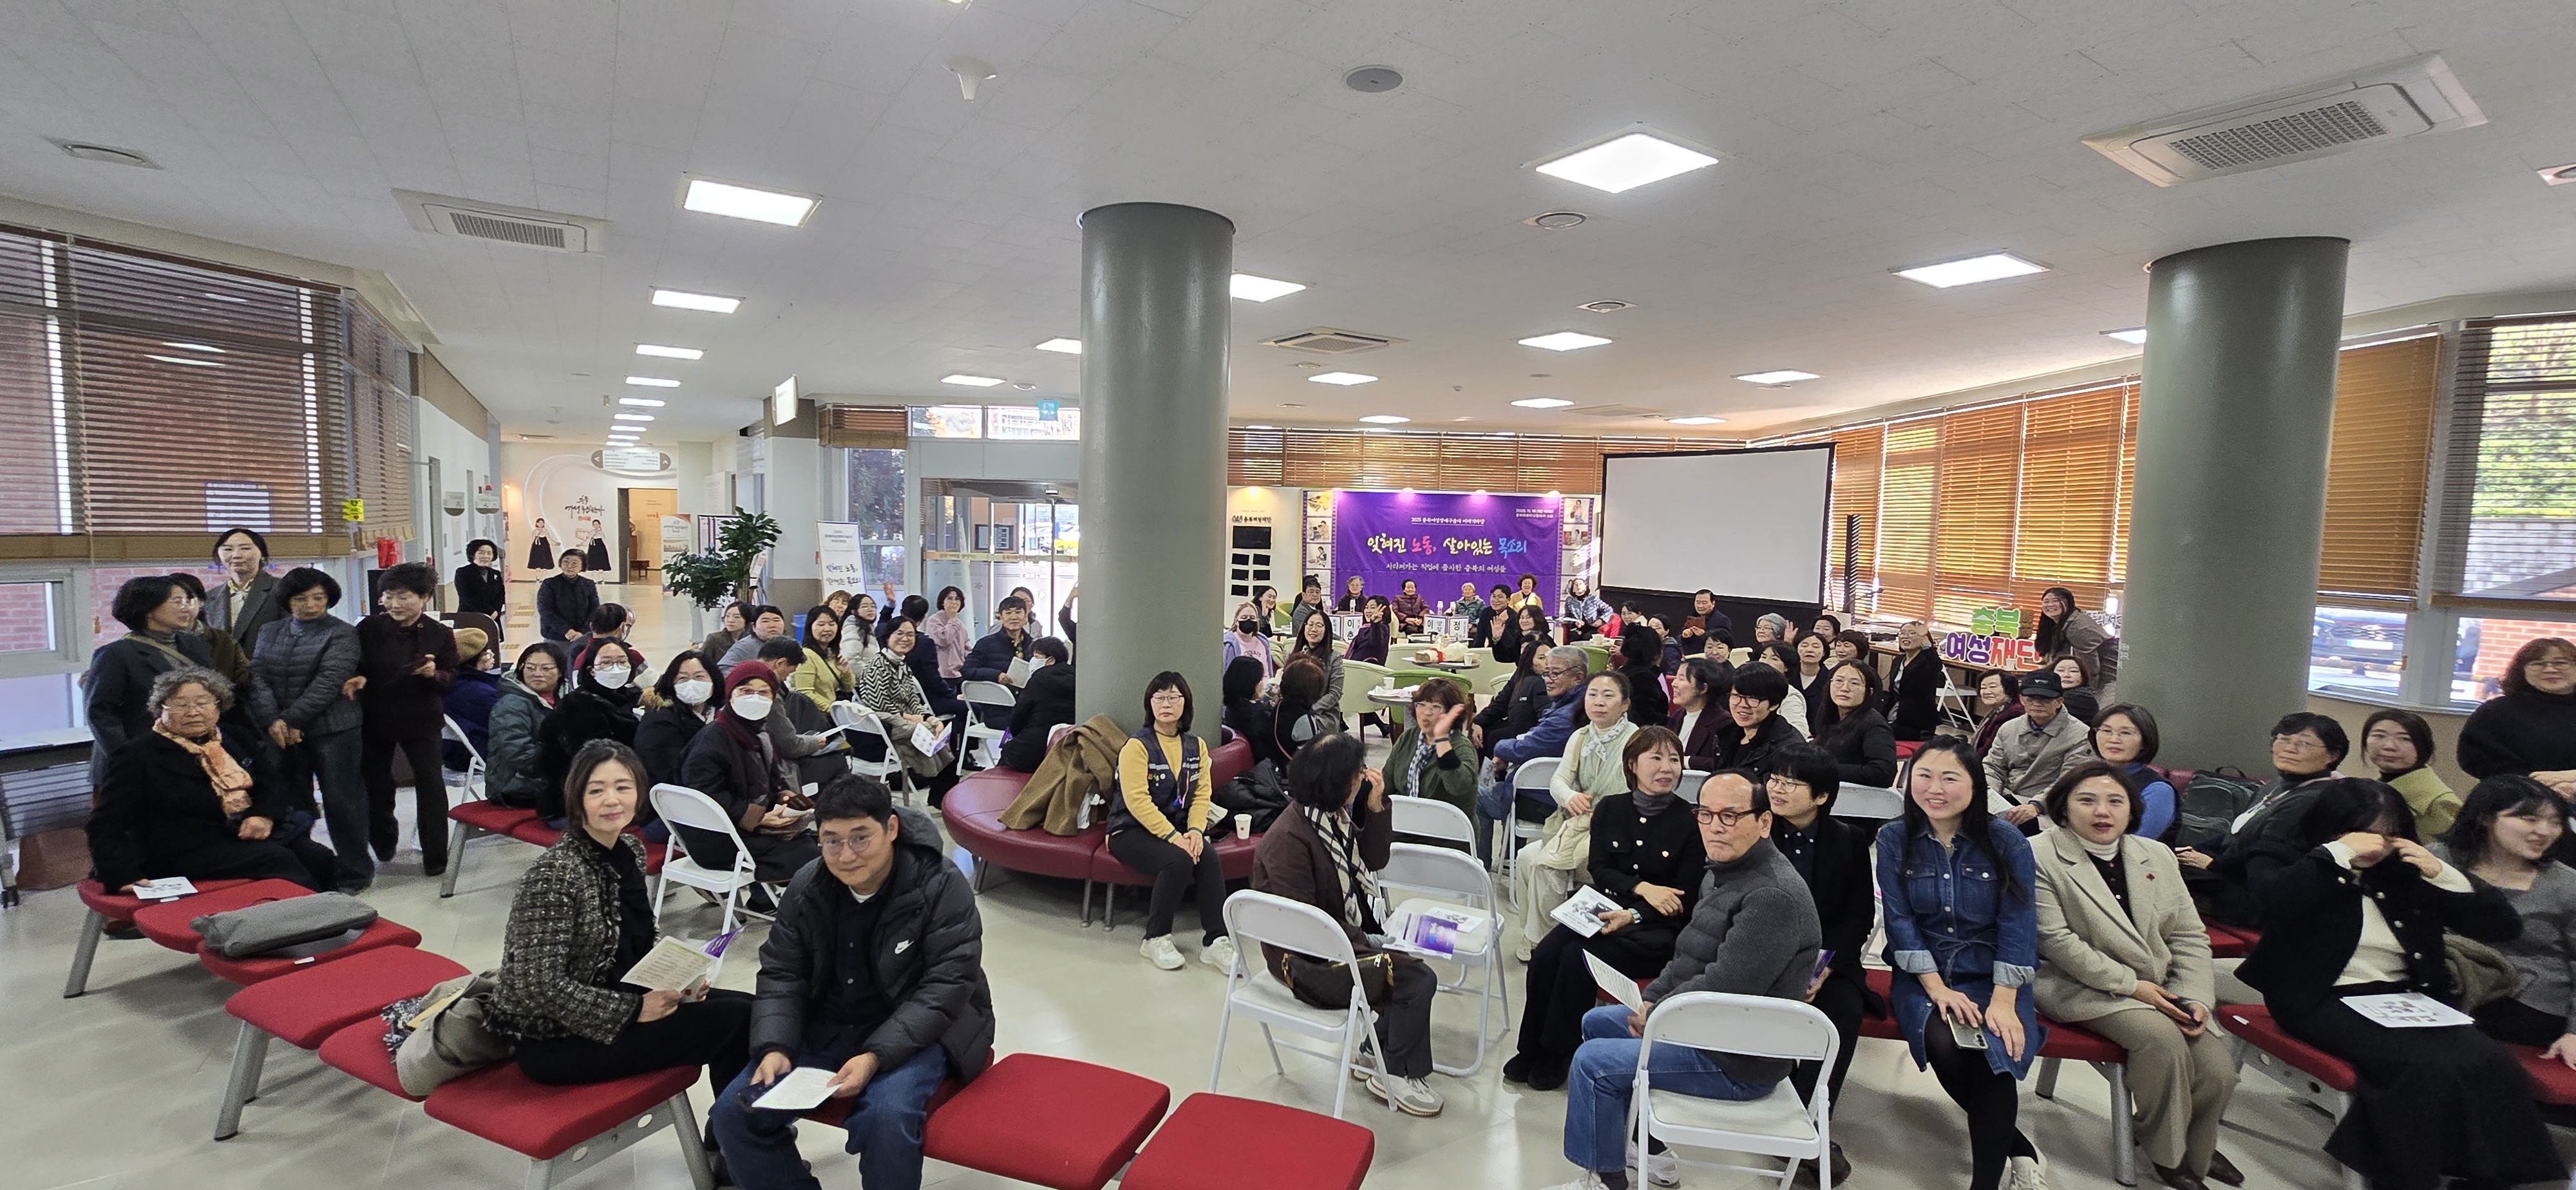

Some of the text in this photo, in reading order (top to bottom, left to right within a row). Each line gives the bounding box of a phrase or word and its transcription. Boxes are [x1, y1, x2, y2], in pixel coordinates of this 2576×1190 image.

[1367, 533, 1527, 559] 잊혀진 노동, 살아있는 목소리
[1386, 562, 1418, 571] 사라져가는
[1421, 562, 1439, 571] 직업에
[1464, 564, 1484, 572] 충북의
[1971, 607, 2020, 638] 충북
[1946, 632, 2041, 670] 여성재단
